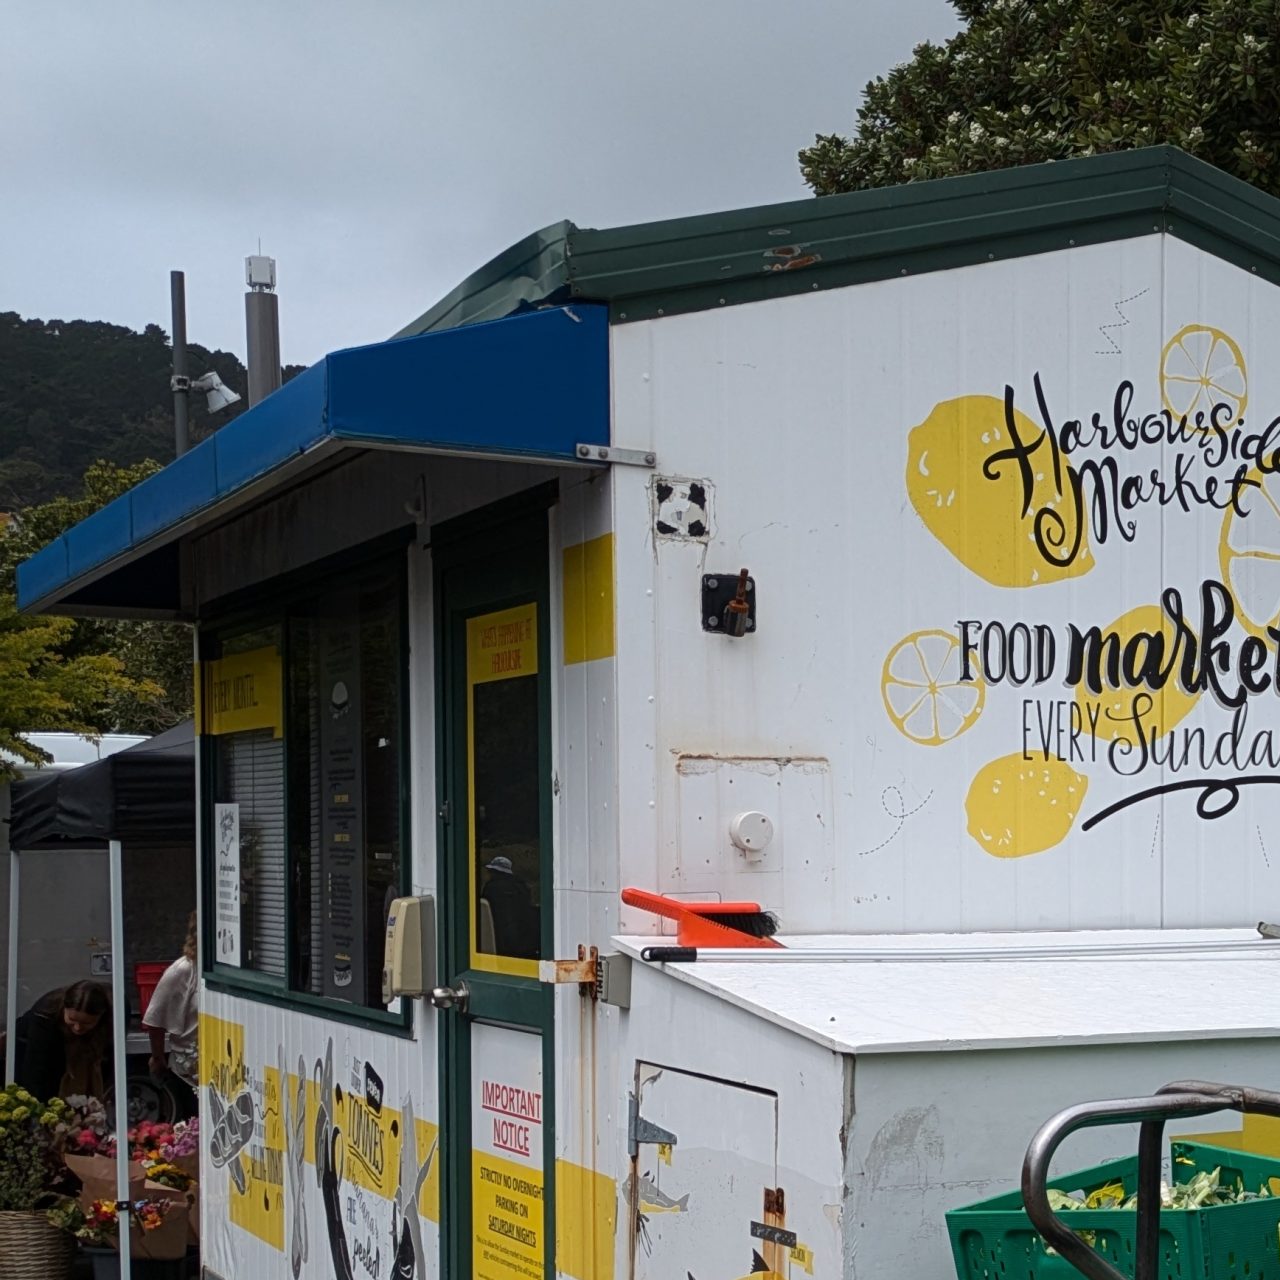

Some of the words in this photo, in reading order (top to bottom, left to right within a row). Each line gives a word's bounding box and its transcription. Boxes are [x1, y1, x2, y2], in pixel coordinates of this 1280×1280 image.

[1034, 453, 1262, 567] Market
[957, 620, 1057, 688] FOOD
[1023, 699, 1100, 762] EVERY
[482, 1080, 542, 1120] IMPORTANT
[348, 1091, 384, 1176] TONNES
[493, 1117, 530, 1152] NOTICE
[480, 1166, 503, 1186] STRICTLY
[503, 1173, 512, 1189] NO
[512, 1177, 545, 1200] OVERNIGHT
[495, 1194, 519, 1215] PARKING
[519, 1203, 529, 1219] ON
[488, 1214, 515, 1235] SATURDAY
[515, 1224, 537, 1246] NIGHTS
